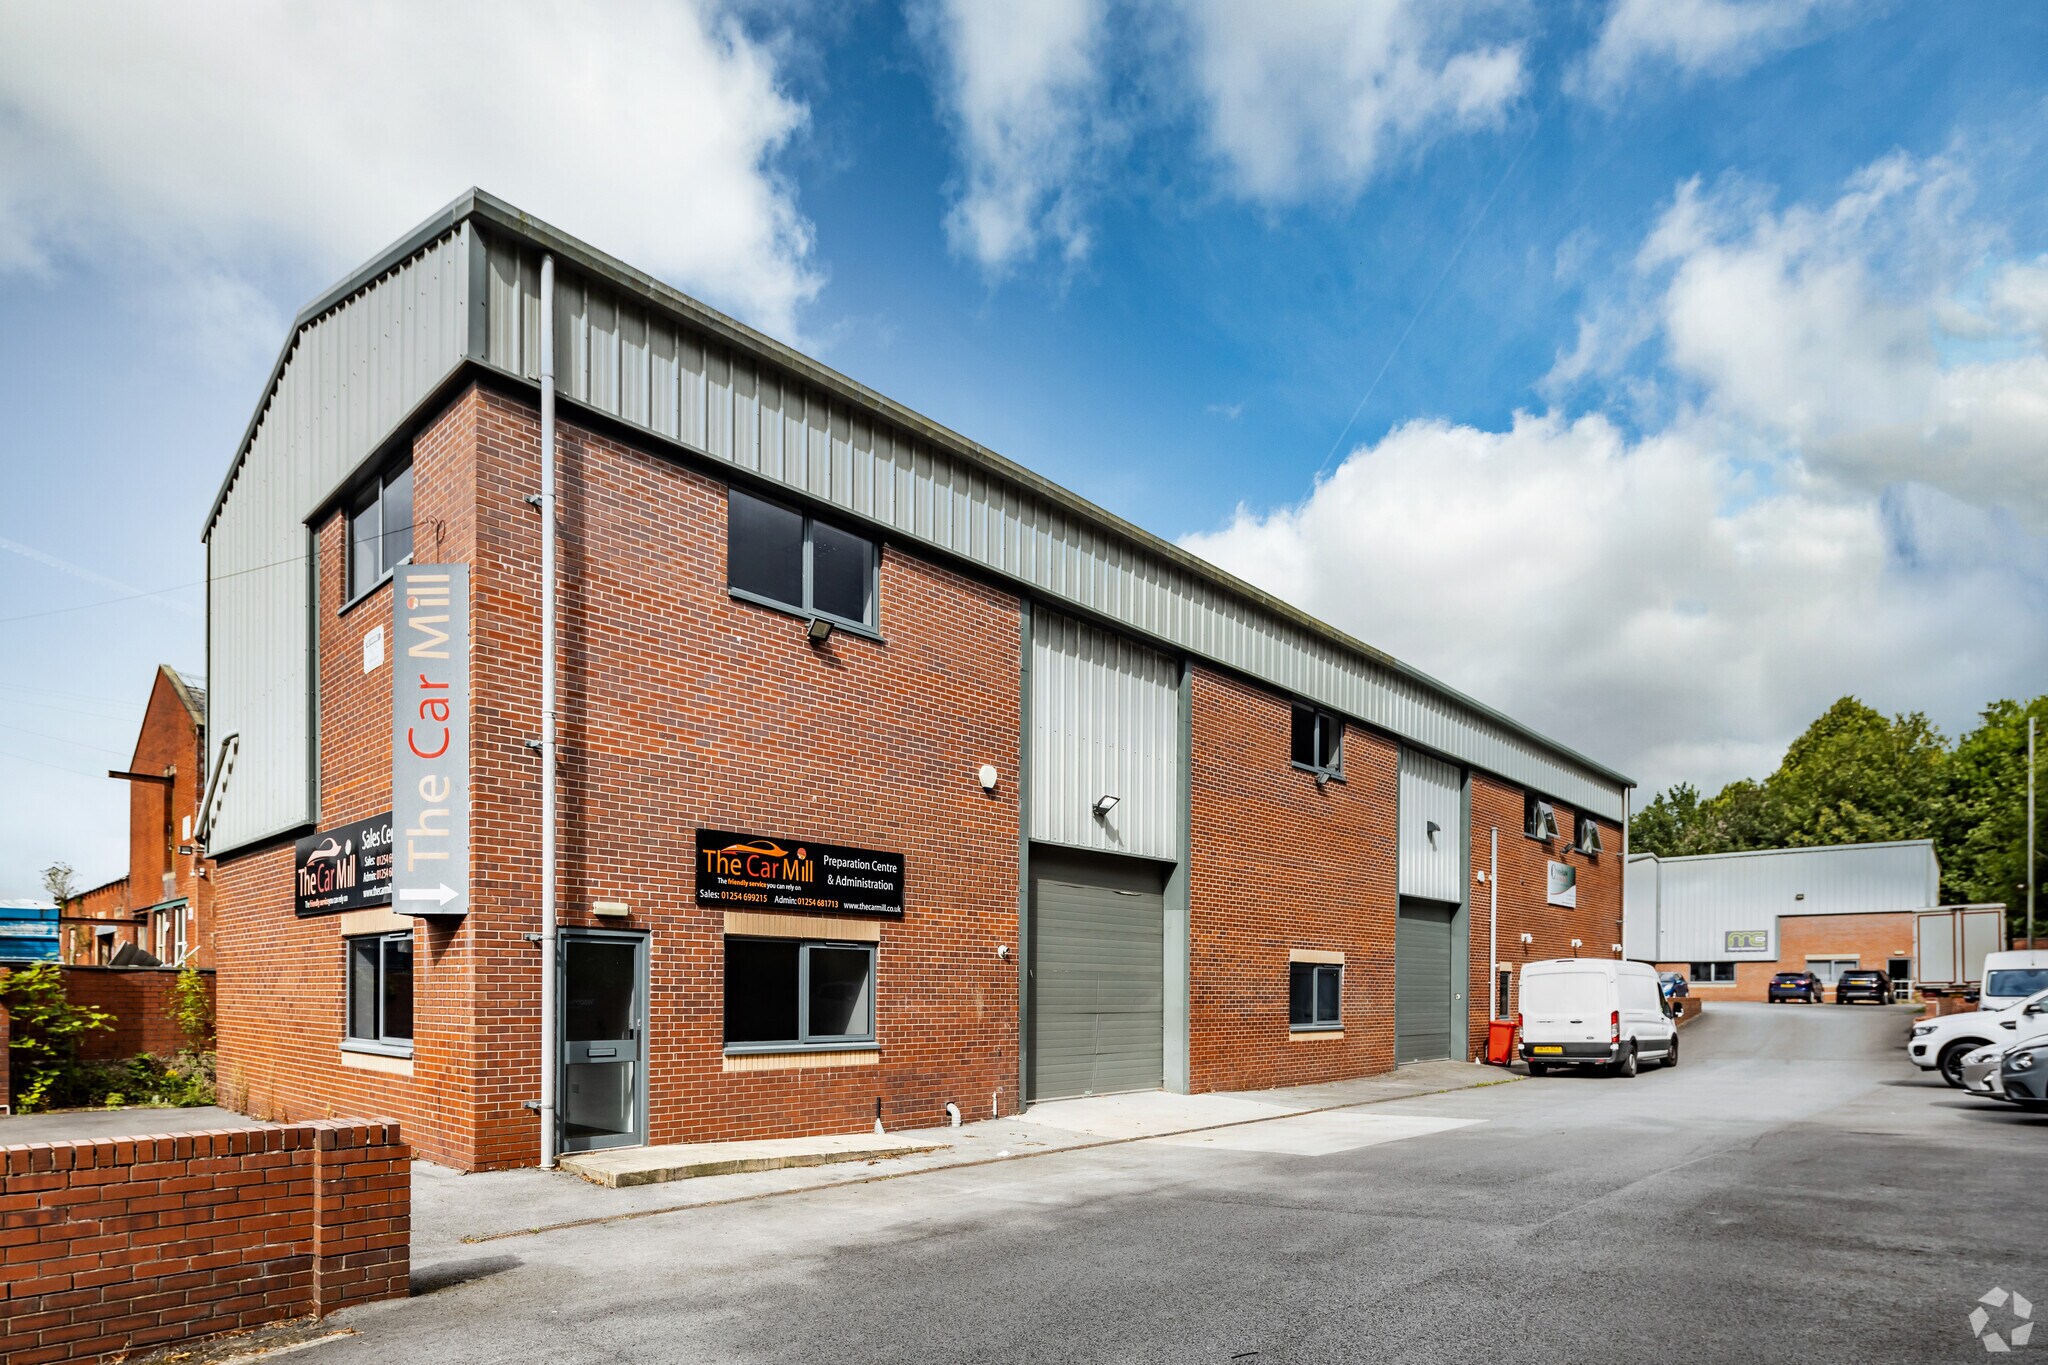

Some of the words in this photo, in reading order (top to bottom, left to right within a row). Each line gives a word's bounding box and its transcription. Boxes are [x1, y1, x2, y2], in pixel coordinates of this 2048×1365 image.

[406, 574, 450, 660] Mill
[407, 674, 450, 759] Car
[405, 773, 450, 873] The
[361, 828, 380, 850] Sales
[298, 866, 316, 897] The
[317, 863, 335, 893] Car
[336, 839, 356, 890] Mill
[703, 849, 742, 876] The
[746, 854, 779, 879] Car
[783, 847, 814, 883] Mill
[823, 854, 870, 870] Preparation
[871, 860, 898, 874] Centre
[717, 877, 727, 885] The
[727, 878, 748, 887] friendly
[749, 880, 766, 888] service
[786, 884, 794, 892] rely
[827, 874, 834, 885] &
[835, 875, 894, 891] Administration
[699, 889, 720, 899] Sales:
[721, 891, 742, 901] 01254
[743, 892, 768, 903] 699215
[774, 895, 797, 905] Admin:
[797, 897, 816, 906] 01254
[816, 898, 839, 908] 681713
[843, 902, 902, 913] www.thecarmill.co.uk
